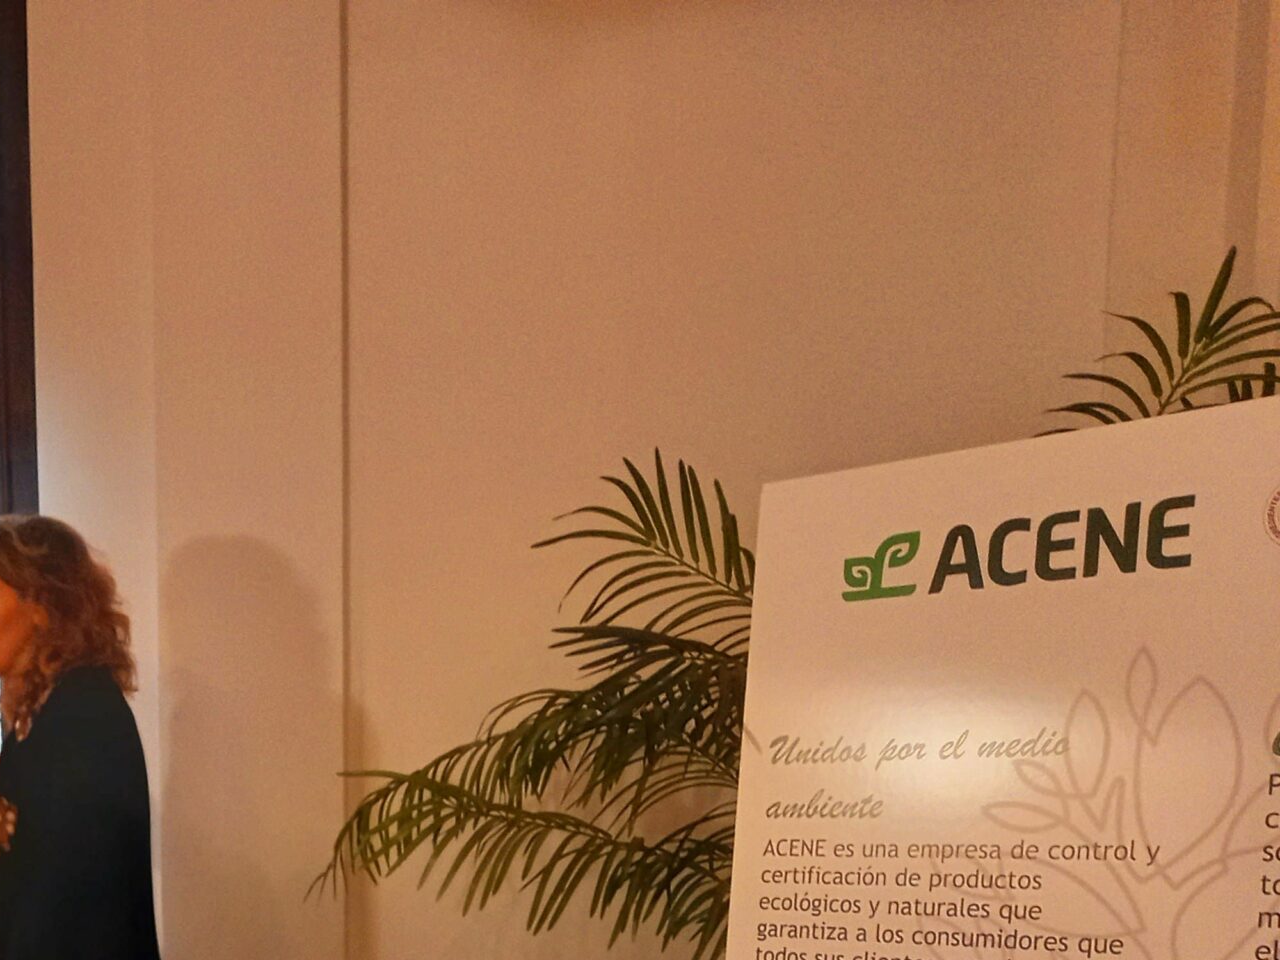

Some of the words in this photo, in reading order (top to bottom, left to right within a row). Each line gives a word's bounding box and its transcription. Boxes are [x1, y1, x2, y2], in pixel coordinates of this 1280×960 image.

[928, 494, 1196, 595] ACENE
[768, 735, 867, 766] Unidos
[875, 740, 926, 771] por
[939, 730, 970, 761] el
[977, 726, 1071, 758] medio
[766, 788, 884, 820] ambiente
[763, 838, 826, 858] ACENE
[833, 844, 854, 858] es
[862, 843, 899, 859] una
[907, 843, 1001, 865] empresa
[1010, 840, 1039, 860] de
[1048, 839, 1136, 862] control
[1146, 844, 1160, 866] y
[761, 866, 887, 887] certificación
[895, 867, 921, 888] de
[929, 869, 1042, 892] productos
[759, 893, 861, 917] ecológicos
[868, 900, 880, 918] y
[888, 897, 990, 920] naturales
[999, 904, 1042, 925] que
[757, 921, 848, 943] garantiza
[856, 928, 867, 942] a
[876, 925, 903, 944] los
[912, 928, 1068, 954] consumidores
[1077, 936, 1124, 959] que
